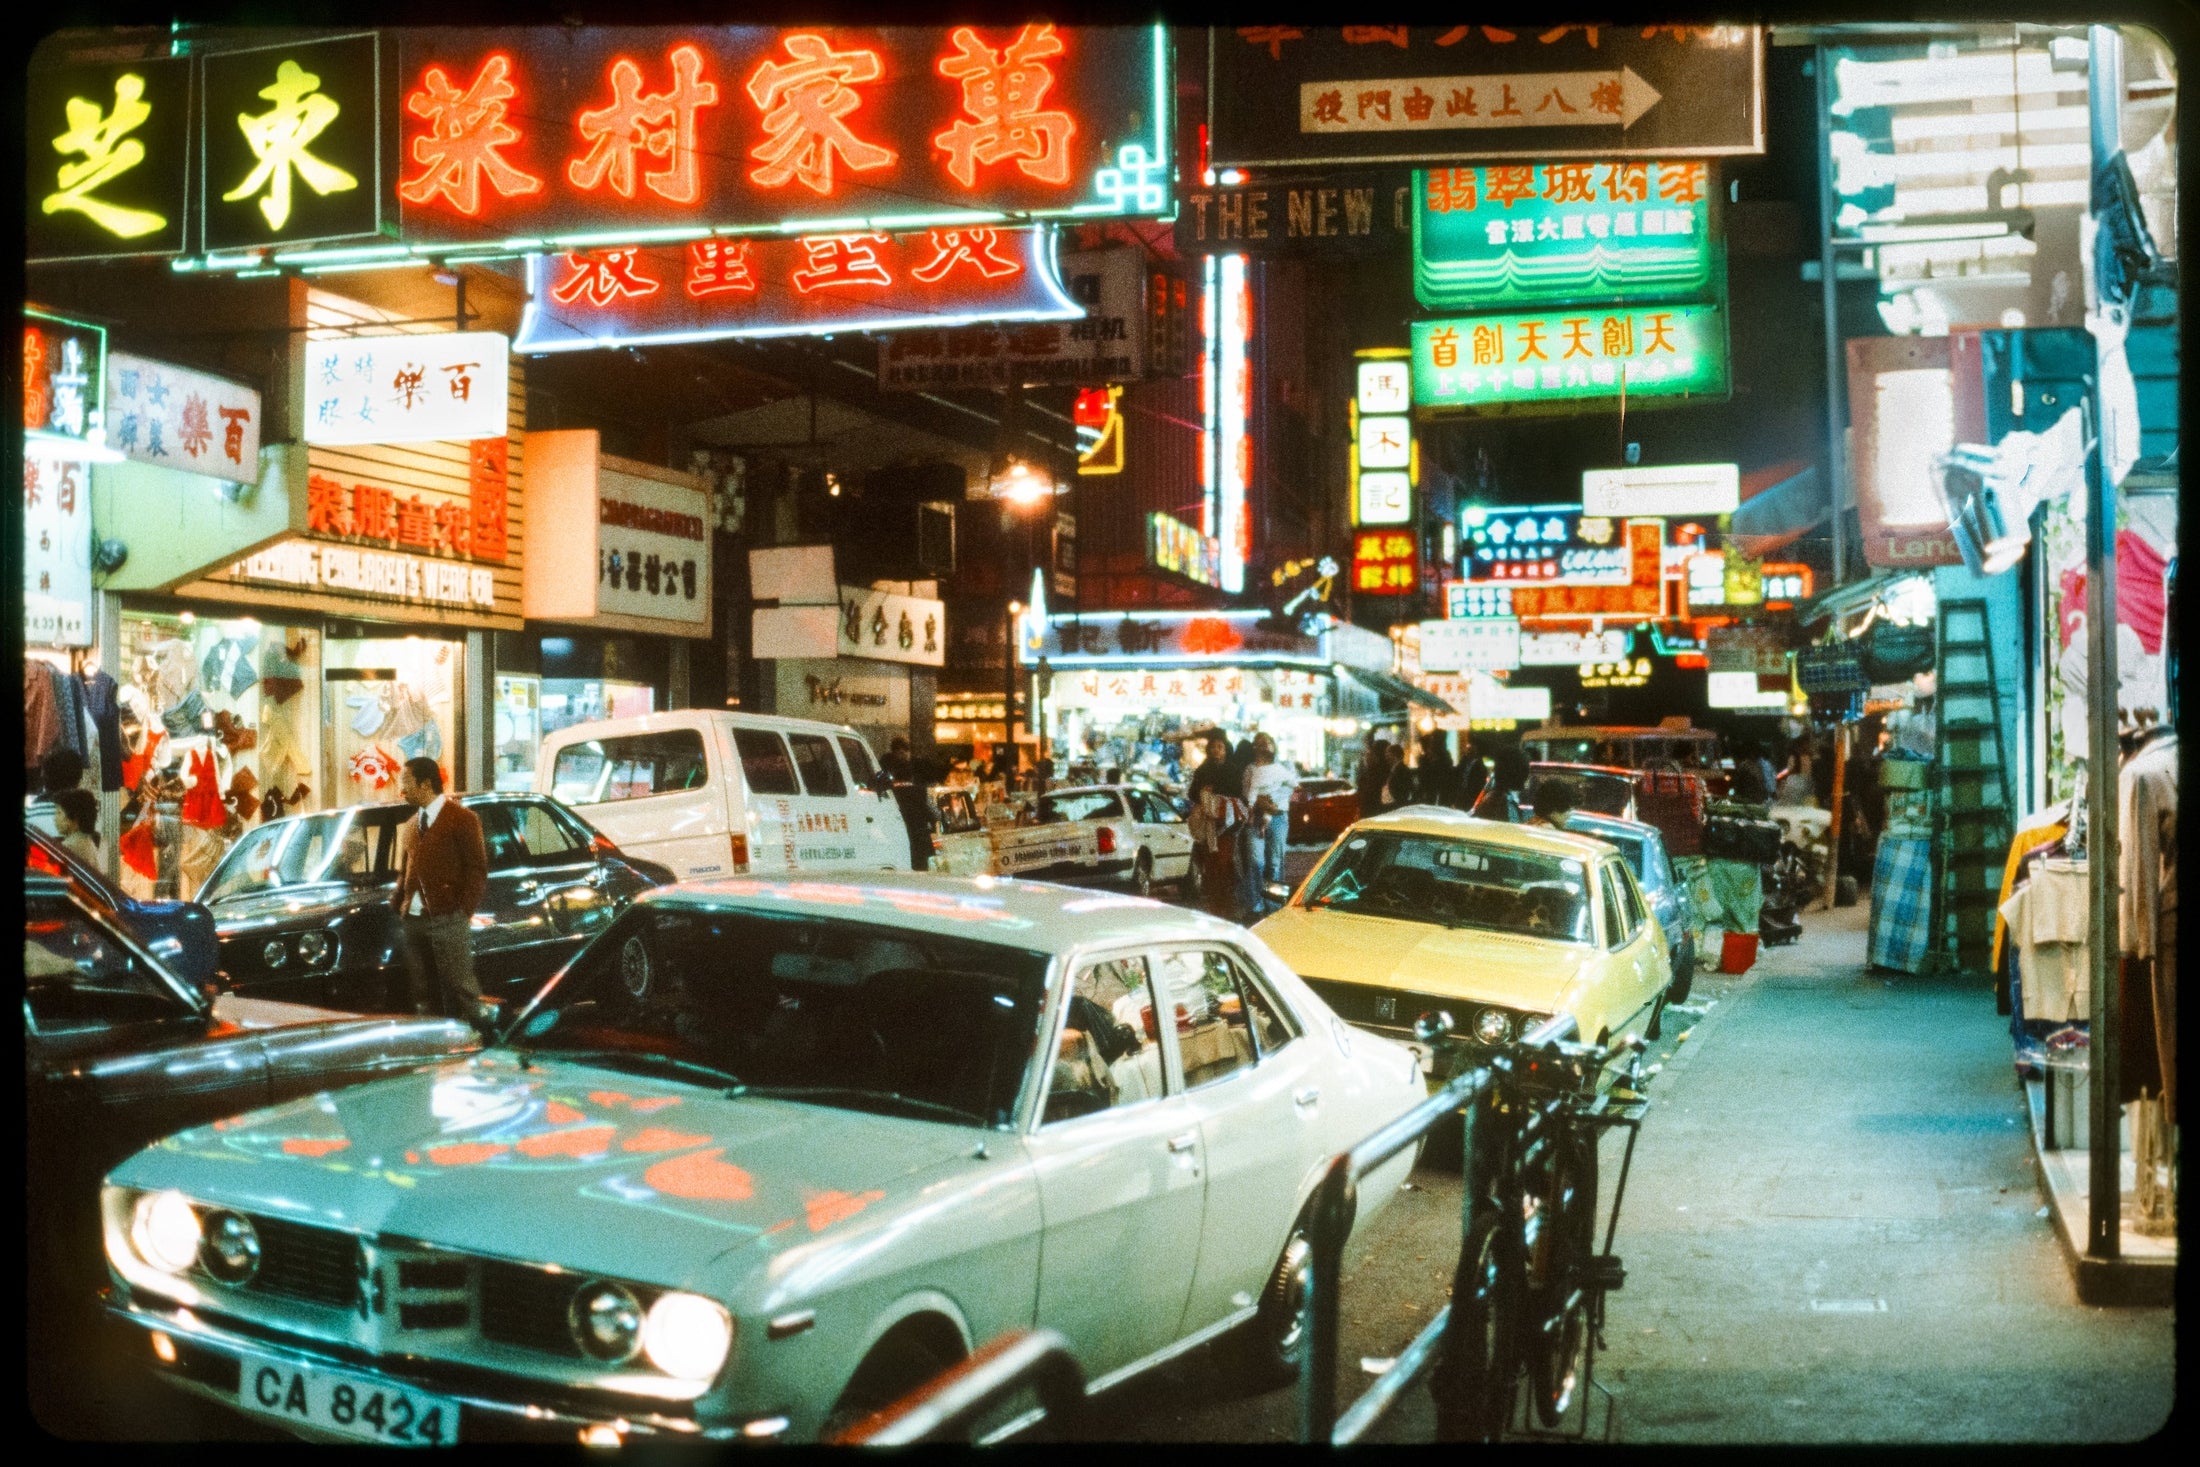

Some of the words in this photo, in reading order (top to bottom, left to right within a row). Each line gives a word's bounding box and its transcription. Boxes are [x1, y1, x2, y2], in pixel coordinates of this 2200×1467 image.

[1190, 191, 1268, 241] THE
[1288, 188, 1374, 238] NEW
[388, 362, 482, 411] 百樂
[178, 388, 251, 466] 百樂
[255, 1365, 309, 1418] CA
[330, 1384, 446, 1446] 8424
